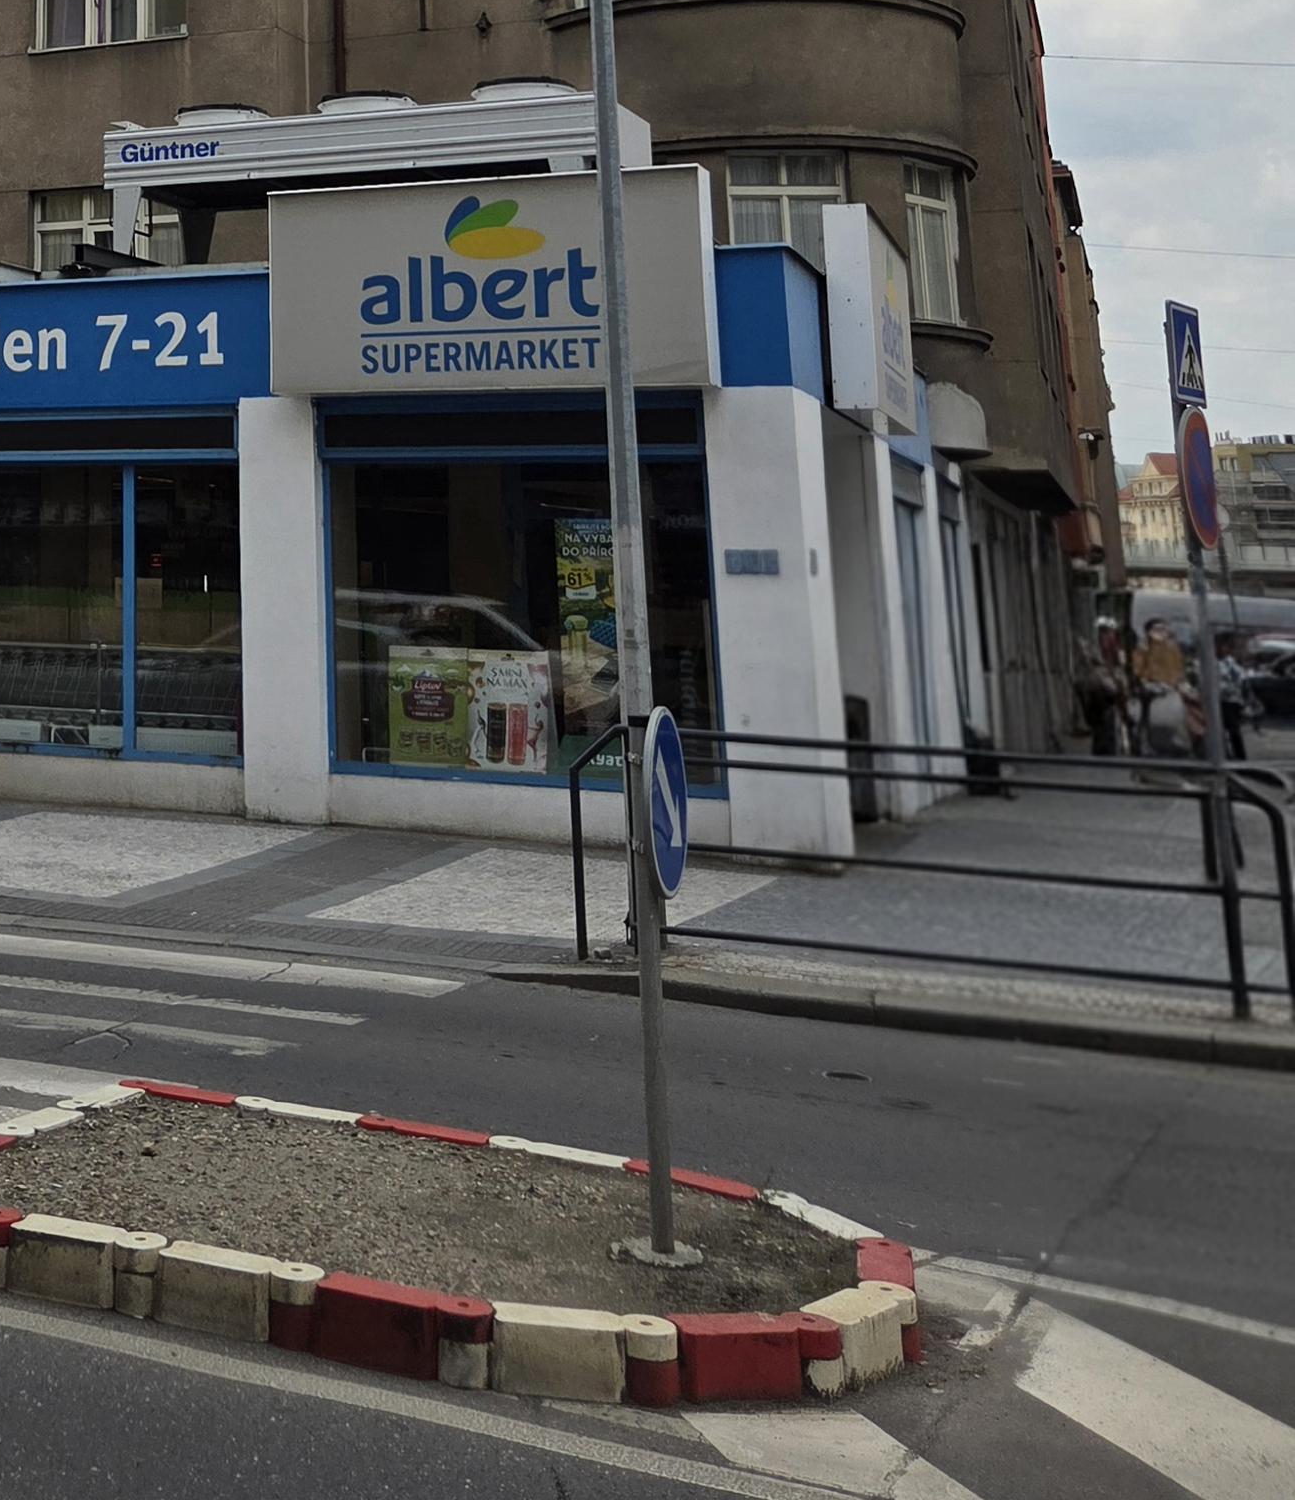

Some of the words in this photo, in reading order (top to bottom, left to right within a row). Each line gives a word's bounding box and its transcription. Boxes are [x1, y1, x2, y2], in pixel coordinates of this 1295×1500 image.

[121, 141, 220, 162] Güntner
[361, 248, 600, 325] albert
[95, 311, 224, 372] 7-21
[361, 337, 601, 375] SUPERMARKET
[562, 547, 580, 556] DO
